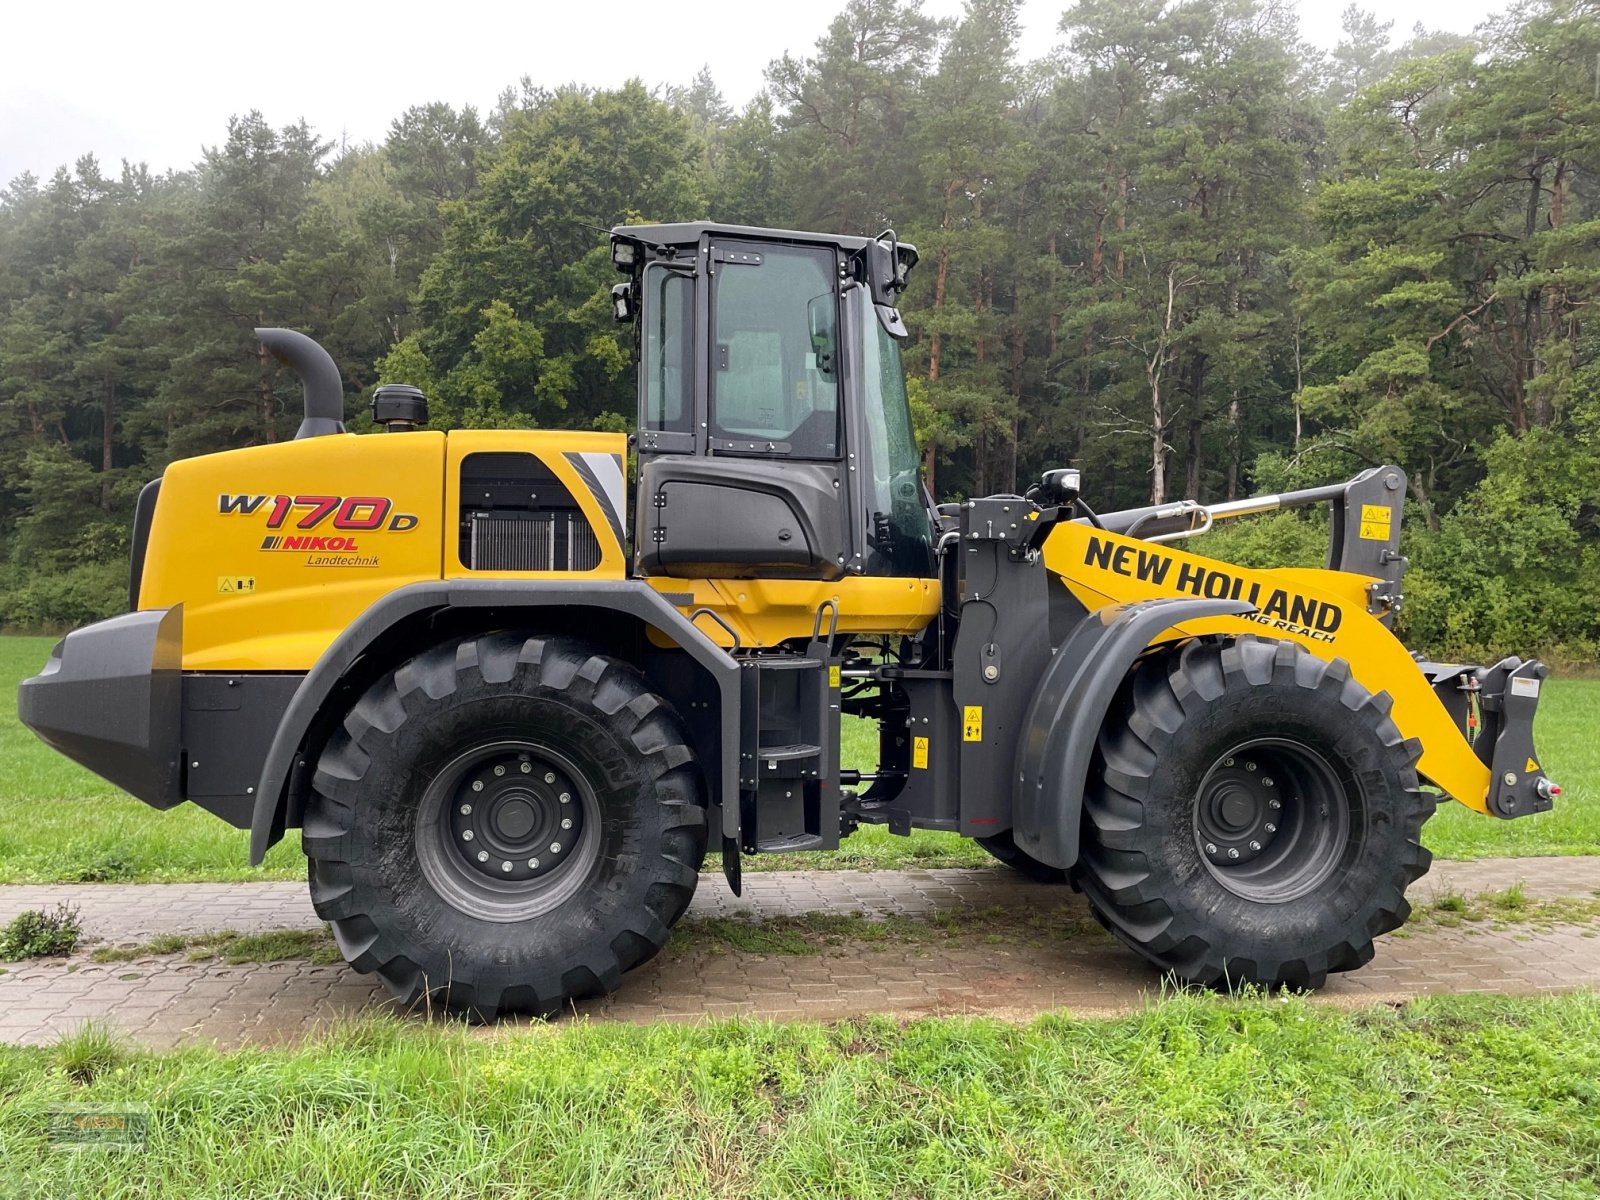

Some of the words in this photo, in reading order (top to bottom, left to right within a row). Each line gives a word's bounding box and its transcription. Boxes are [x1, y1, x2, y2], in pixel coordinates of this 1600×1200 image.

[282, 536, 359, 551] NIKOL
[307, 555, 380, 566] Landtechnik
[1084, 536, 1172, 585] NEW
[1176, 563, 1342, 634] HOLLAND
[1273, 620, 1336, 644] REACH
